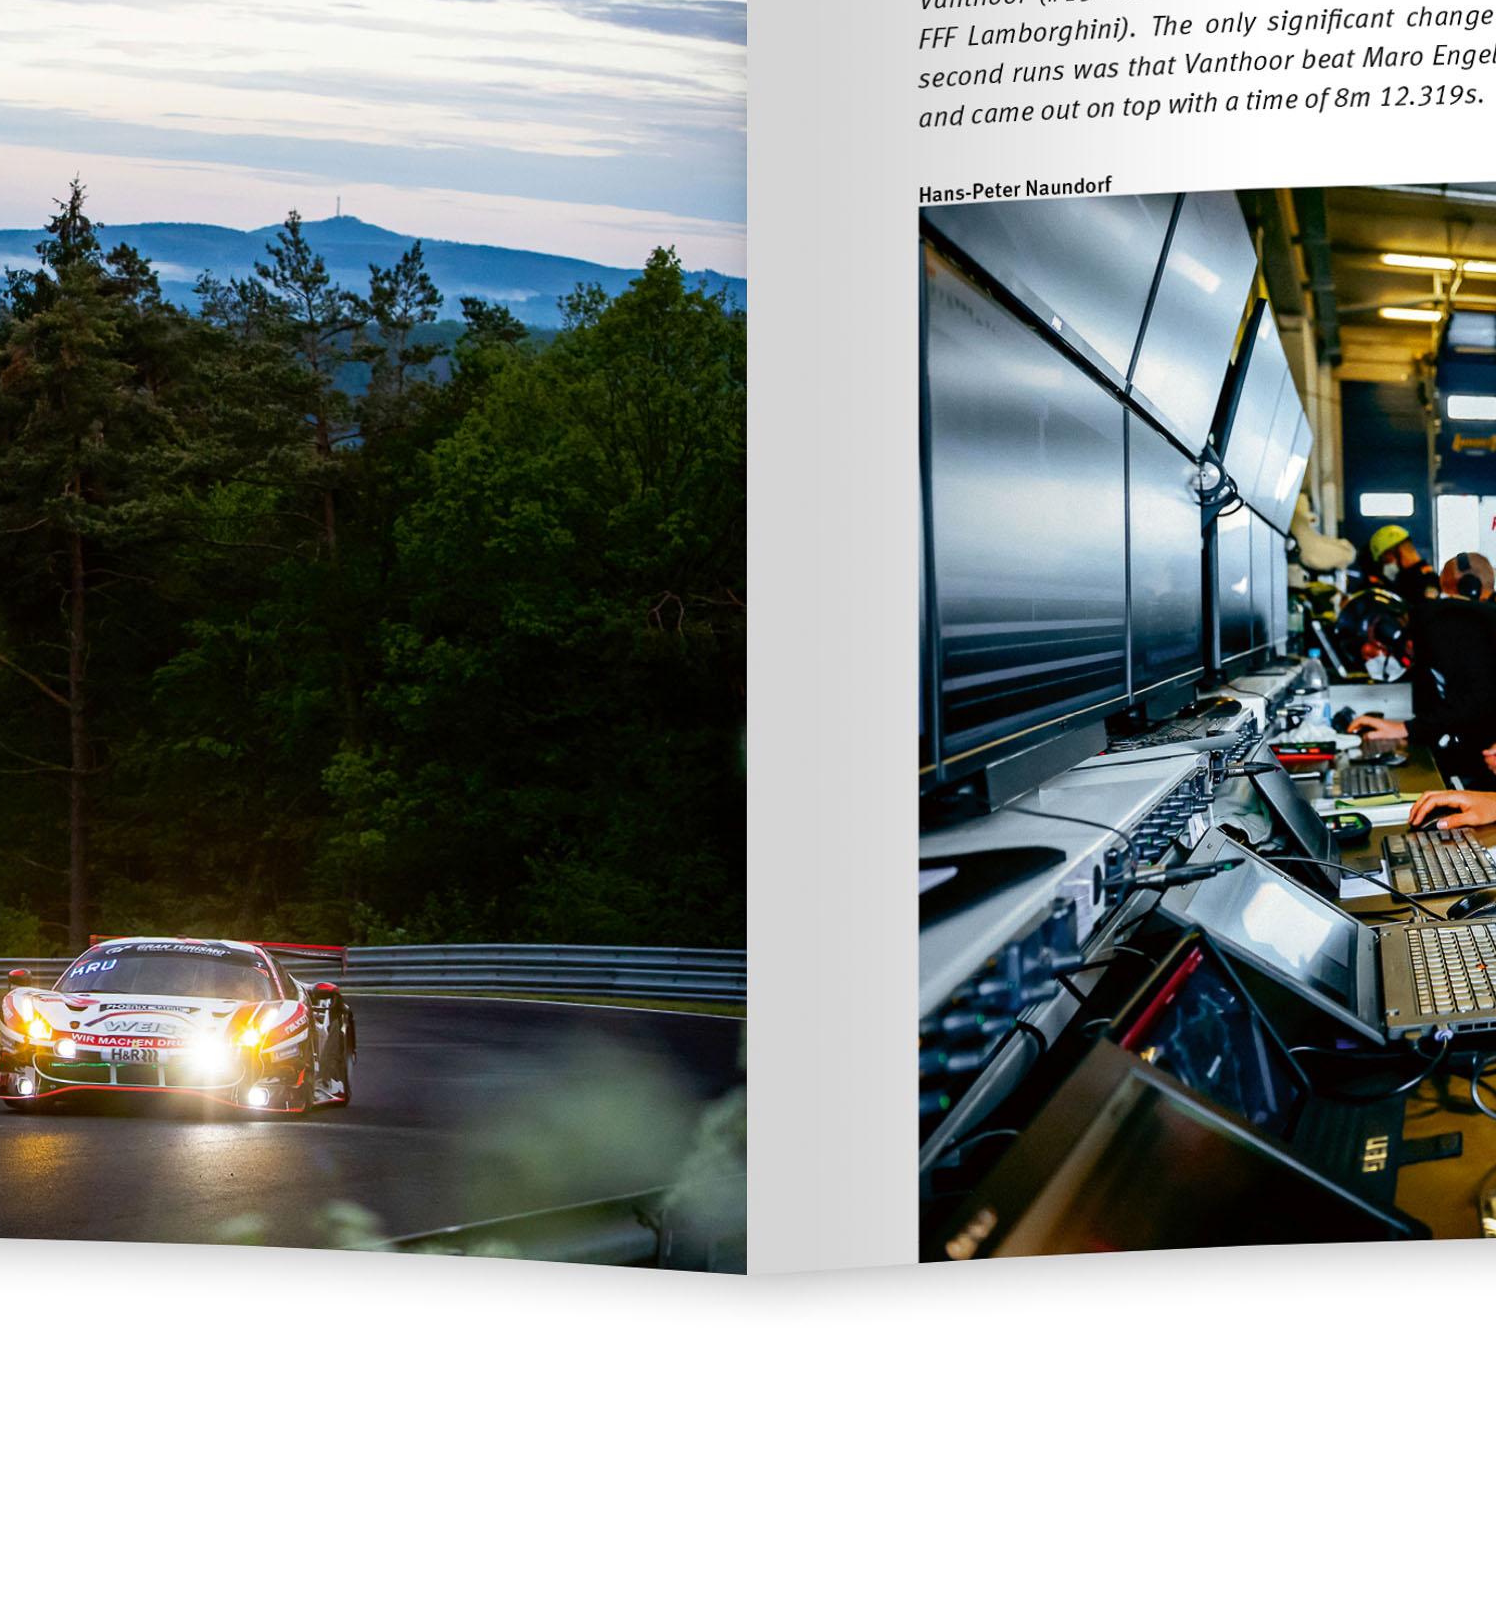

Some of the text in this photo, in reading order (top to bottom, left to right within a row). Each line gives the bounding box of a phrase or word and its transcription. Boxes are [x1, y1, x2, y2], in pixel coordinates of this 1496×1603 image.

[919, 175, 1113, 203] Hans-Peter Naundorf
[72, 1032, 154, 1047] WIR MACHEN
